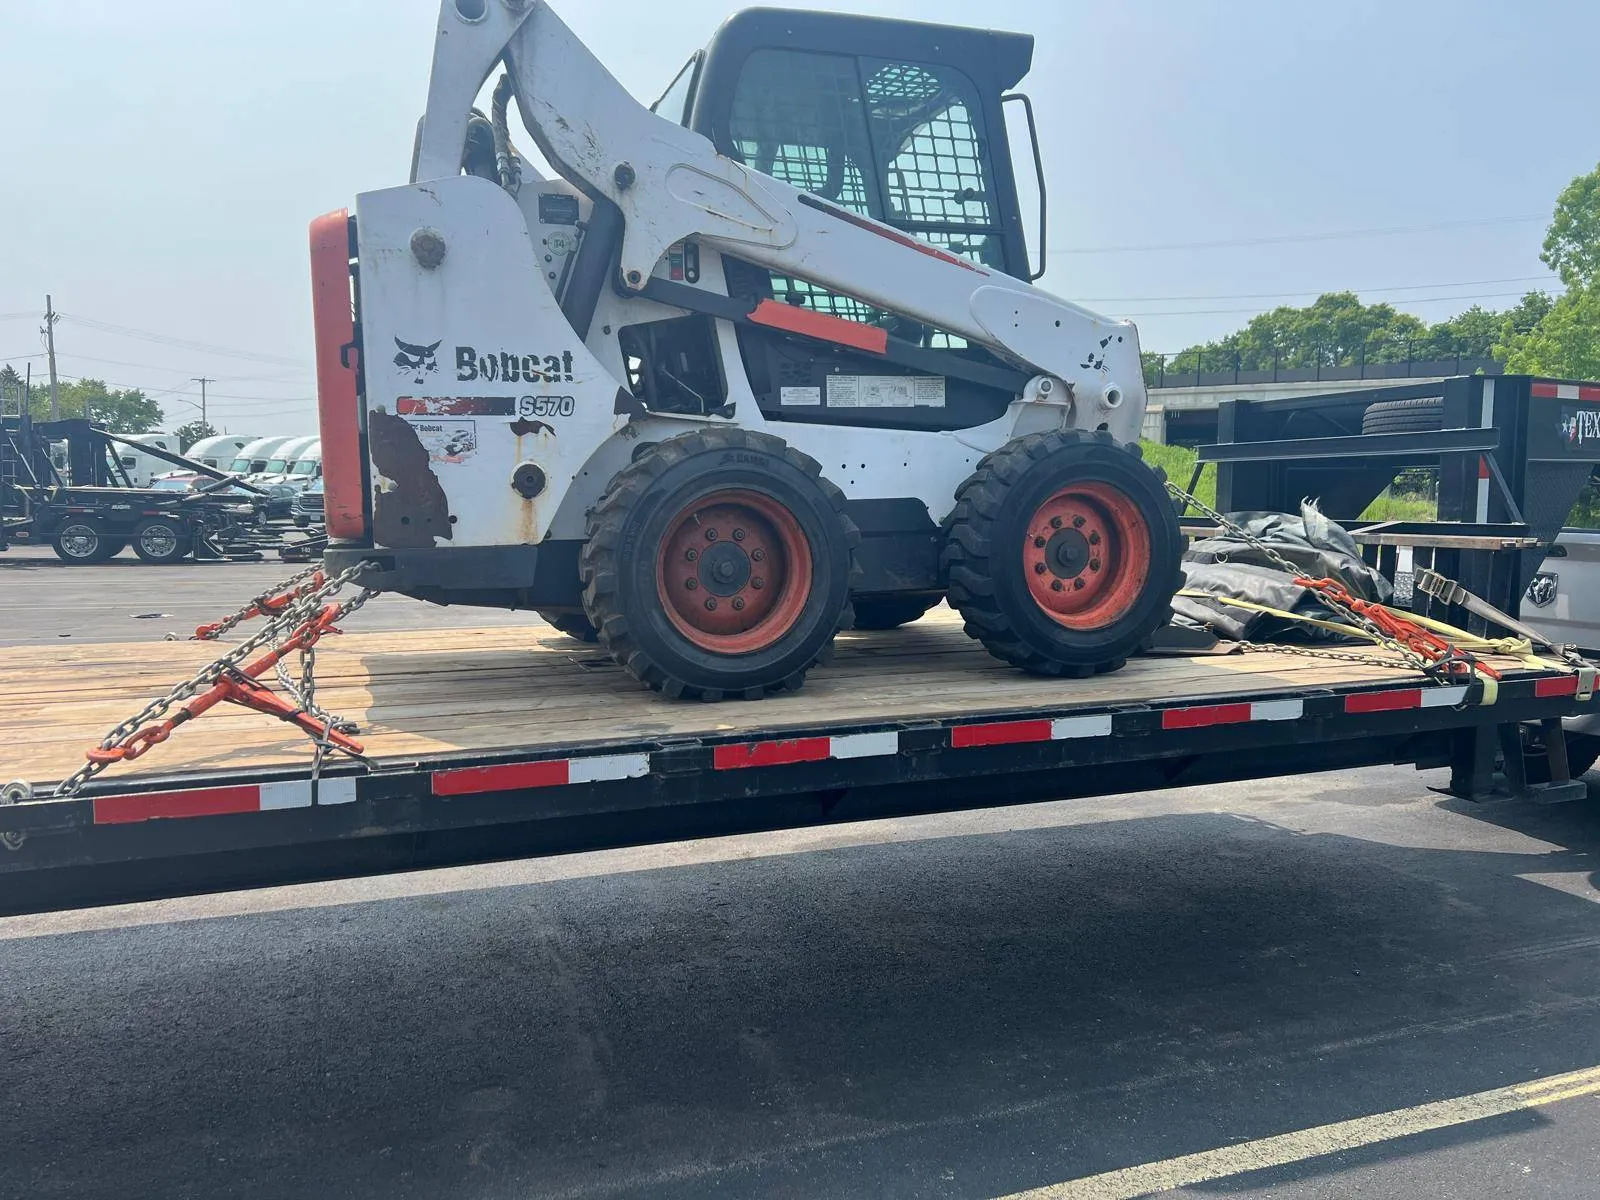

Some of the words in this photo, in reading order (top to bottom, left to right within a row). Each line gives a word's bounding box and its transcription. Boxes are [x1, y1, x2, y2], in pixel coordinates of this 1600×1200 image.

[455, 346, 574, 383] Bobcat
[519, 395, 575, 416] S570
[419, 424, 443, 432] Bobcat
[1576, 410, 1600, 445] TEX
